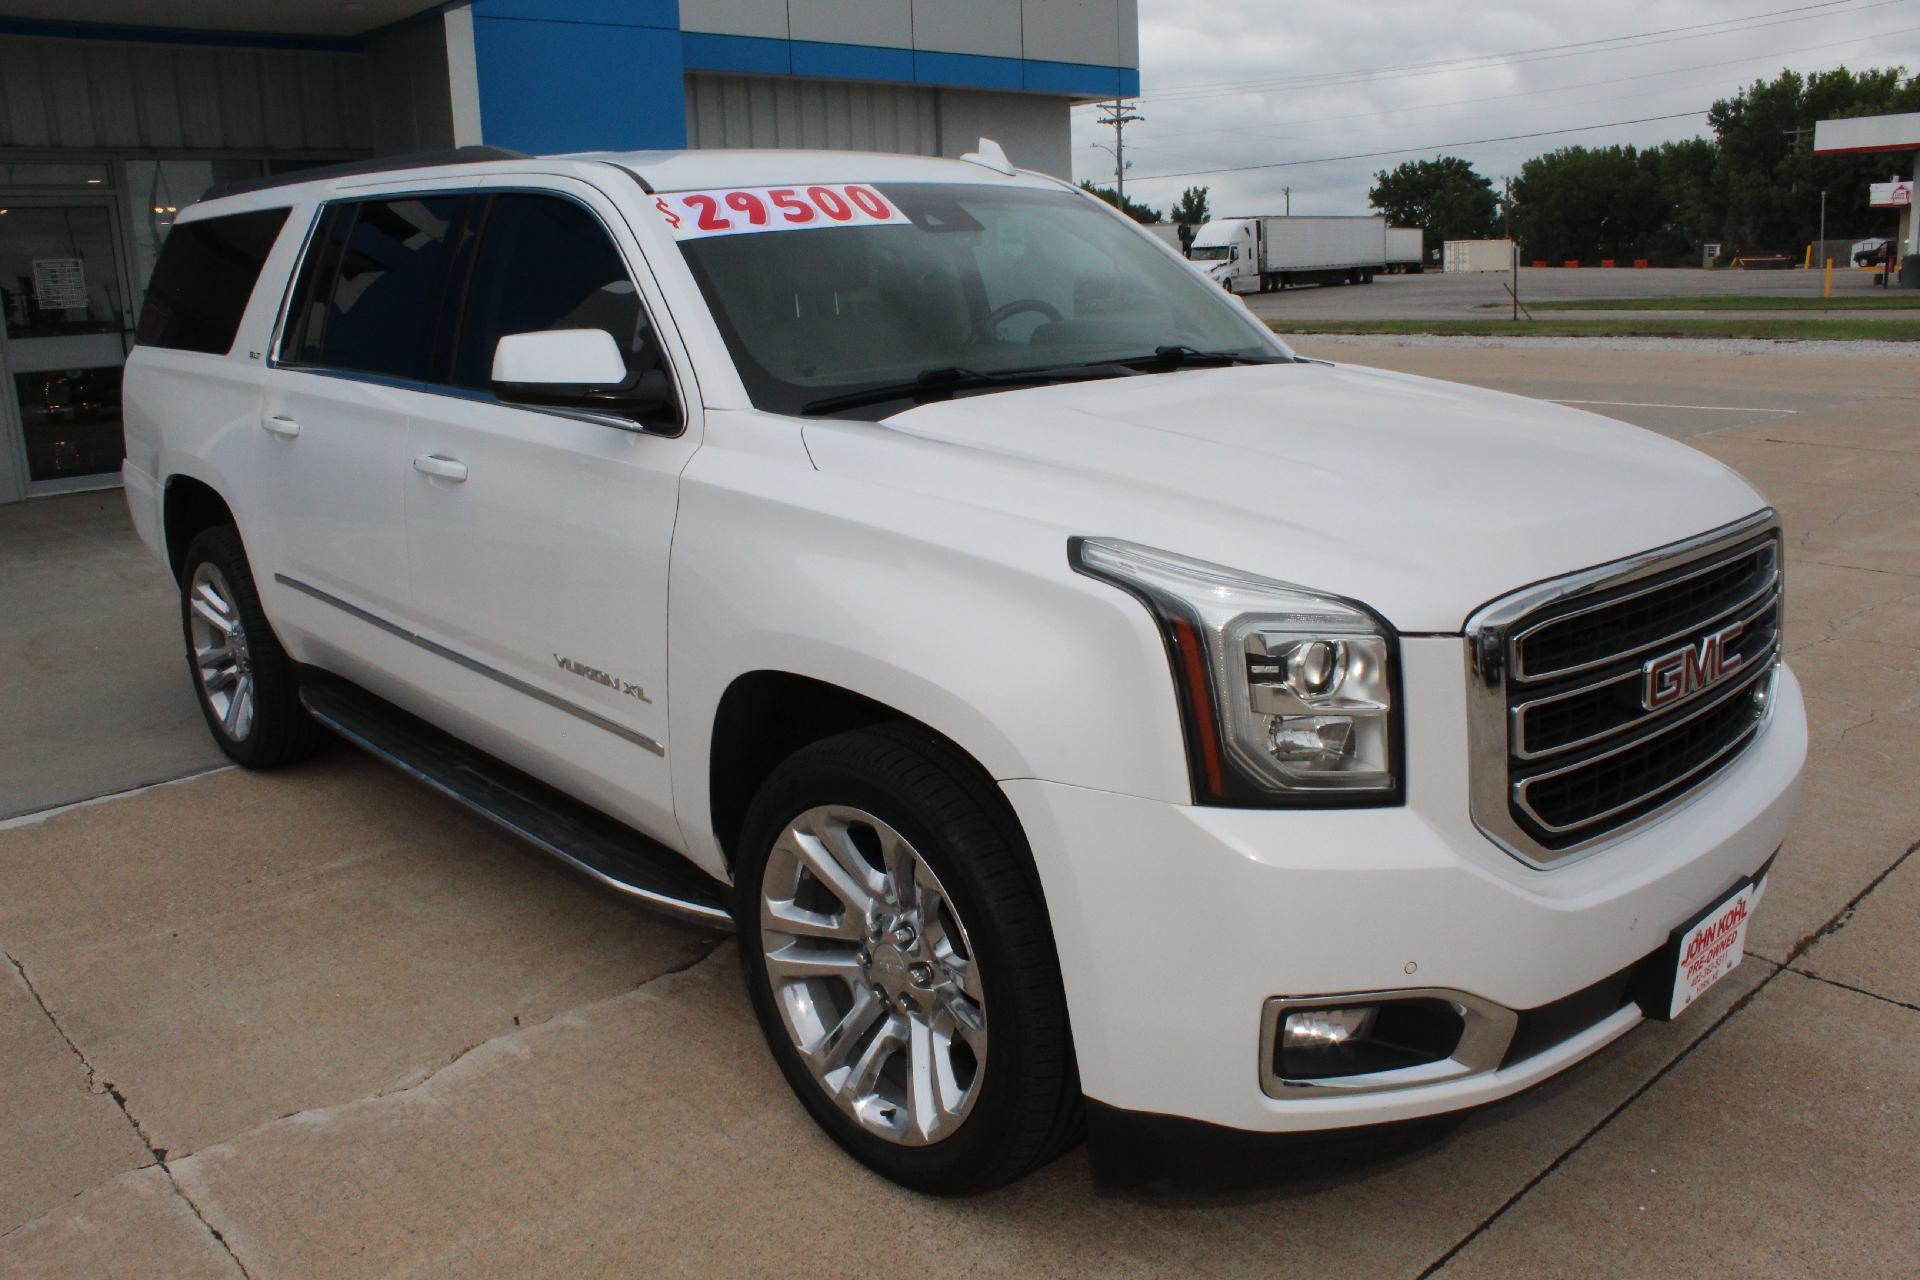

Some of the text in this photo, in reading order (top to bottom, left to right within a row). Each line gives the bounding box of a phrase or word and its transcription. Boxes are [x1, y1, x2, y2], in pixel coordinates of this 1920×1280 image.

[656, 185, 892, 231] $29500
[553, 653, 653, 704] YUKON XL
[1641, 620, 1745, 711] GMC
[1681, 900, 1747, 966] JOHN KOHL
[1687, 931, 1737, 980] PRE-OWNED
